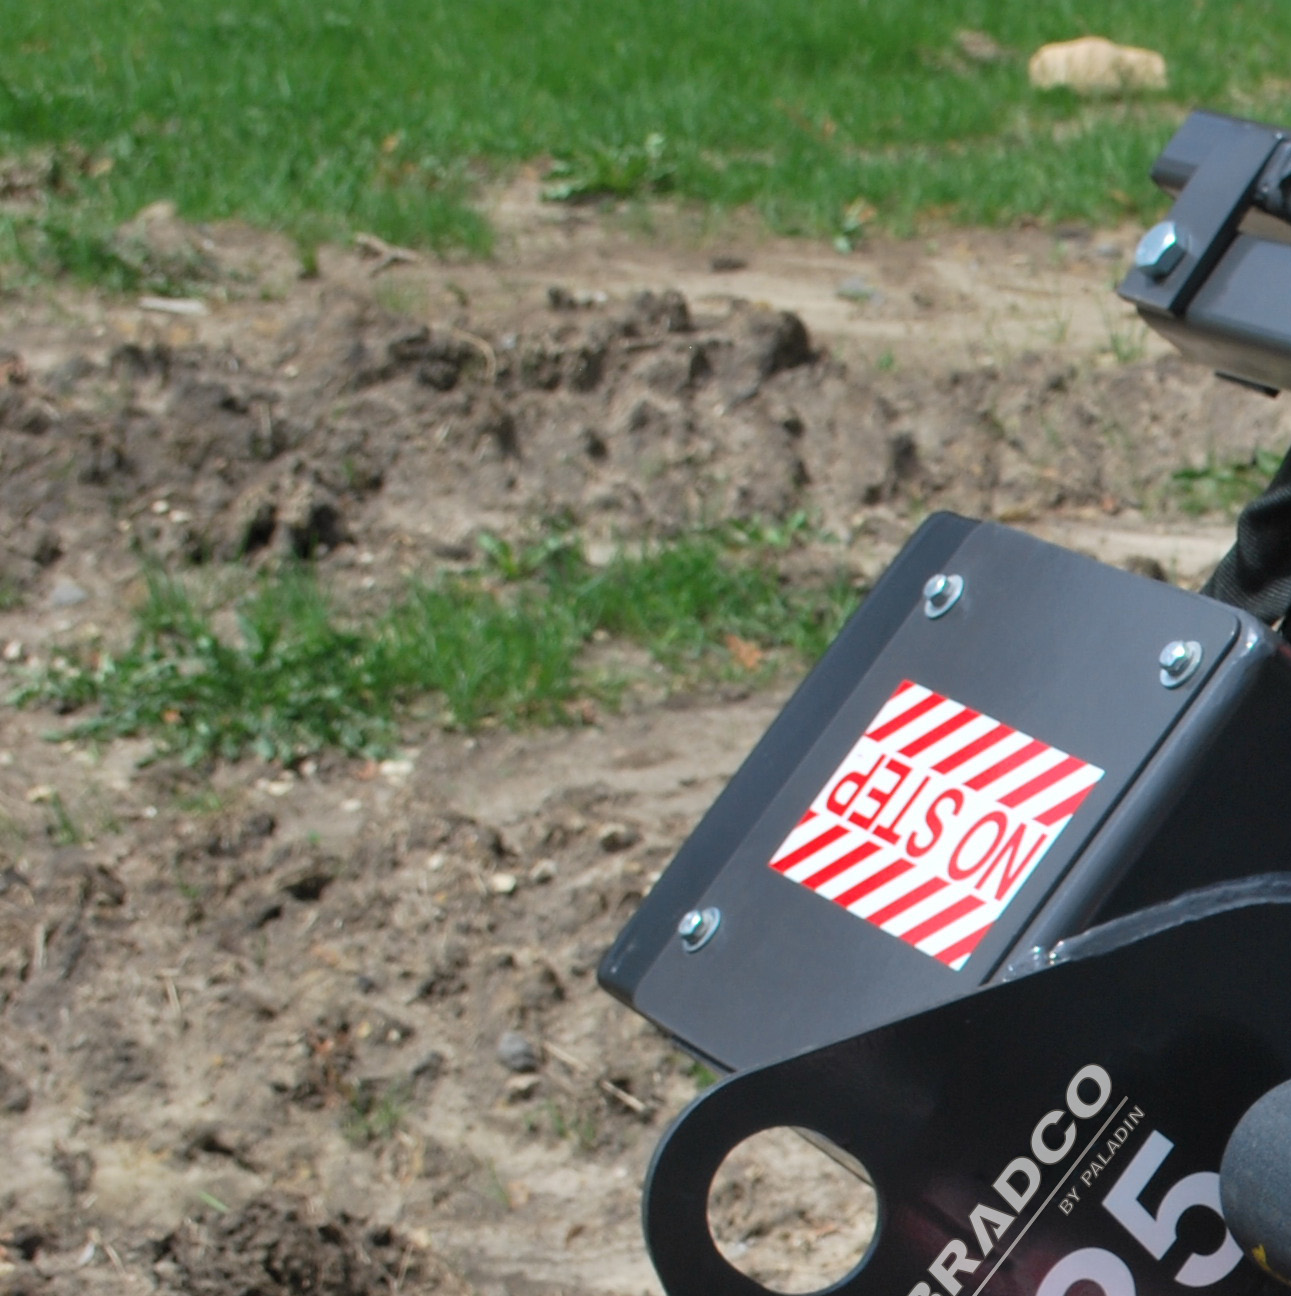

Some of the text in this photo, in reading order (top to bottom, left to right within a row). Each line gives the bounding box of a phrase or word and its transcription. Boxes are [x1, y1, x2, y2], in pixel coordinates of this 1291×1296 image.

[825, 753, 1048, 901] NO STEP
[1058, 1105, 1146, 1216] BY PALADIN
